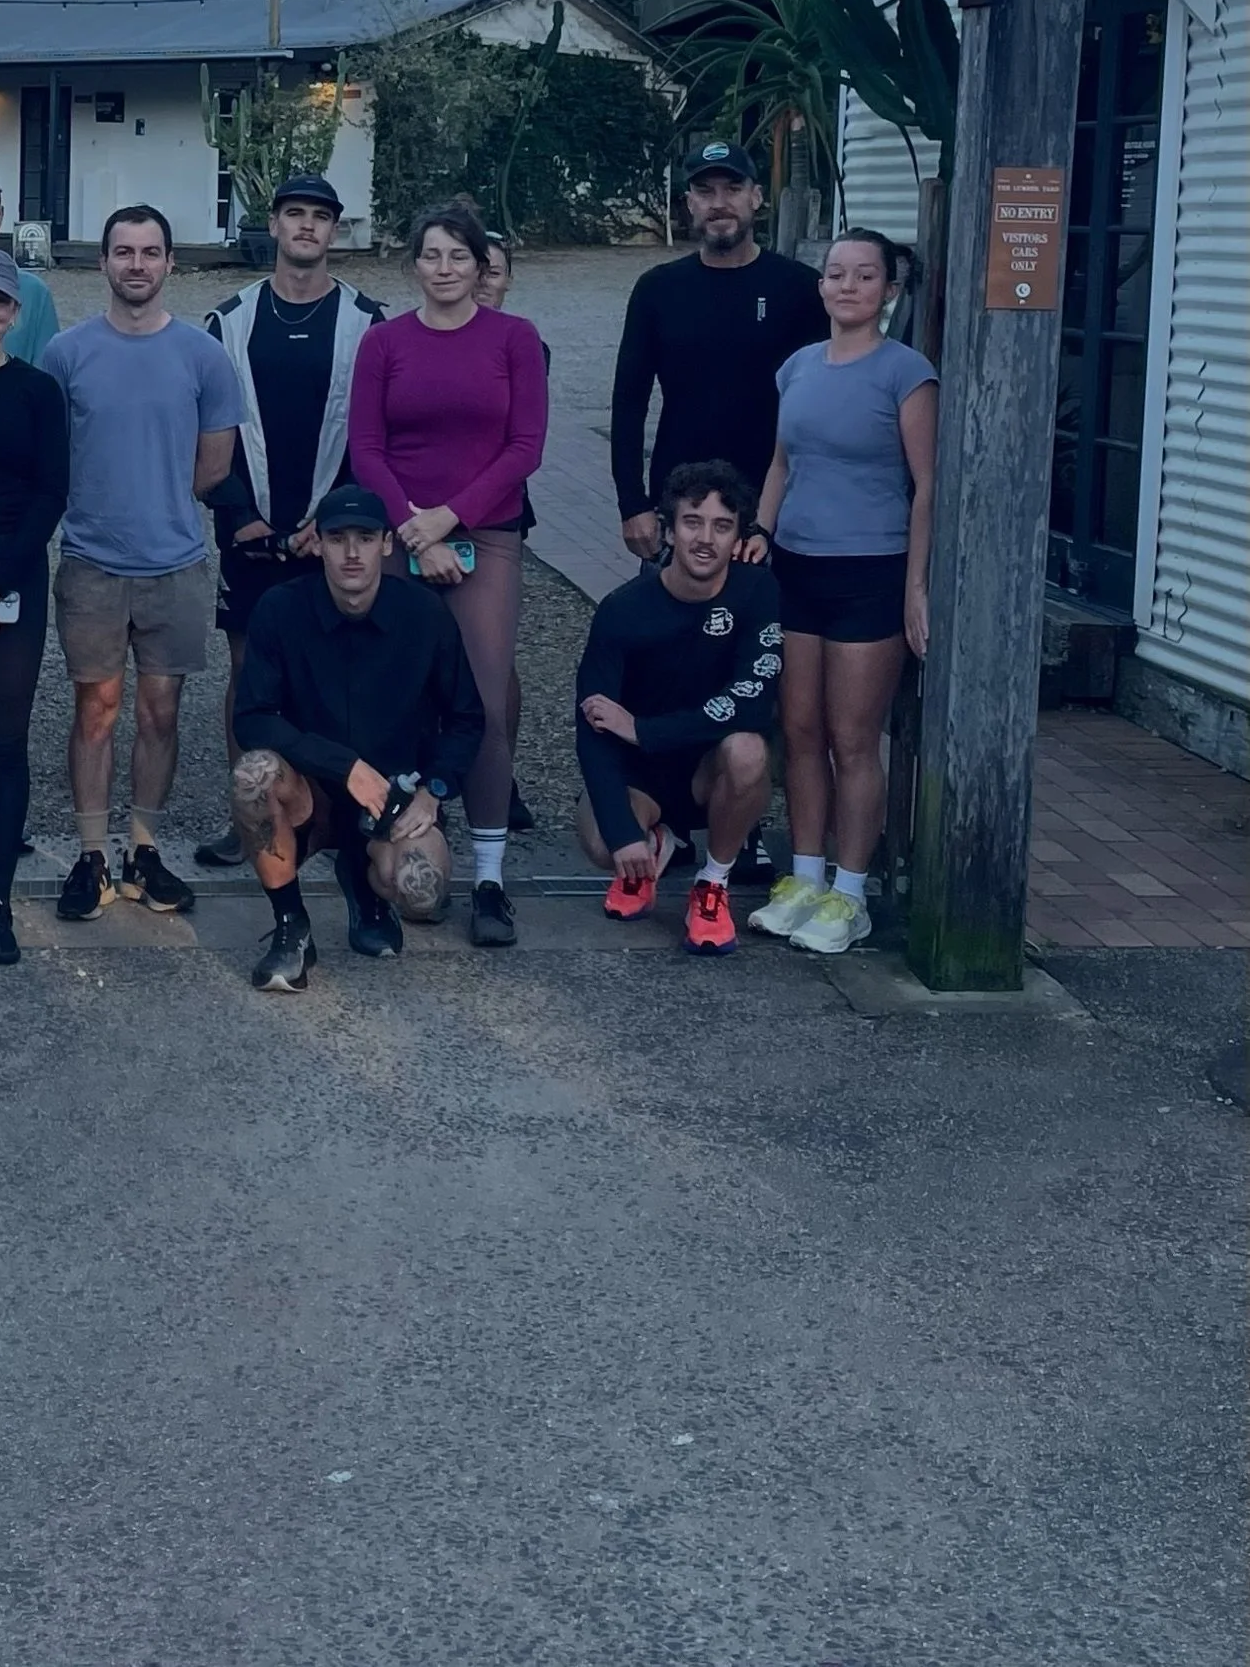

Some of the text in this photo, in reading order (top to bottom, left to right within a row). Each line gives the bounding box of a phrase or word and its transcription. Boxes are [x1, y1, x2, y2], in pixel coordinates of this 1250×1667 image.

[1000, 207, 1055, 219] NO ENTRY
[1002, 232, 1048, 244] VISITORS
[1011, 247, 1038, 257] CARS
[1011, 261, 1037, 271] ONLY
